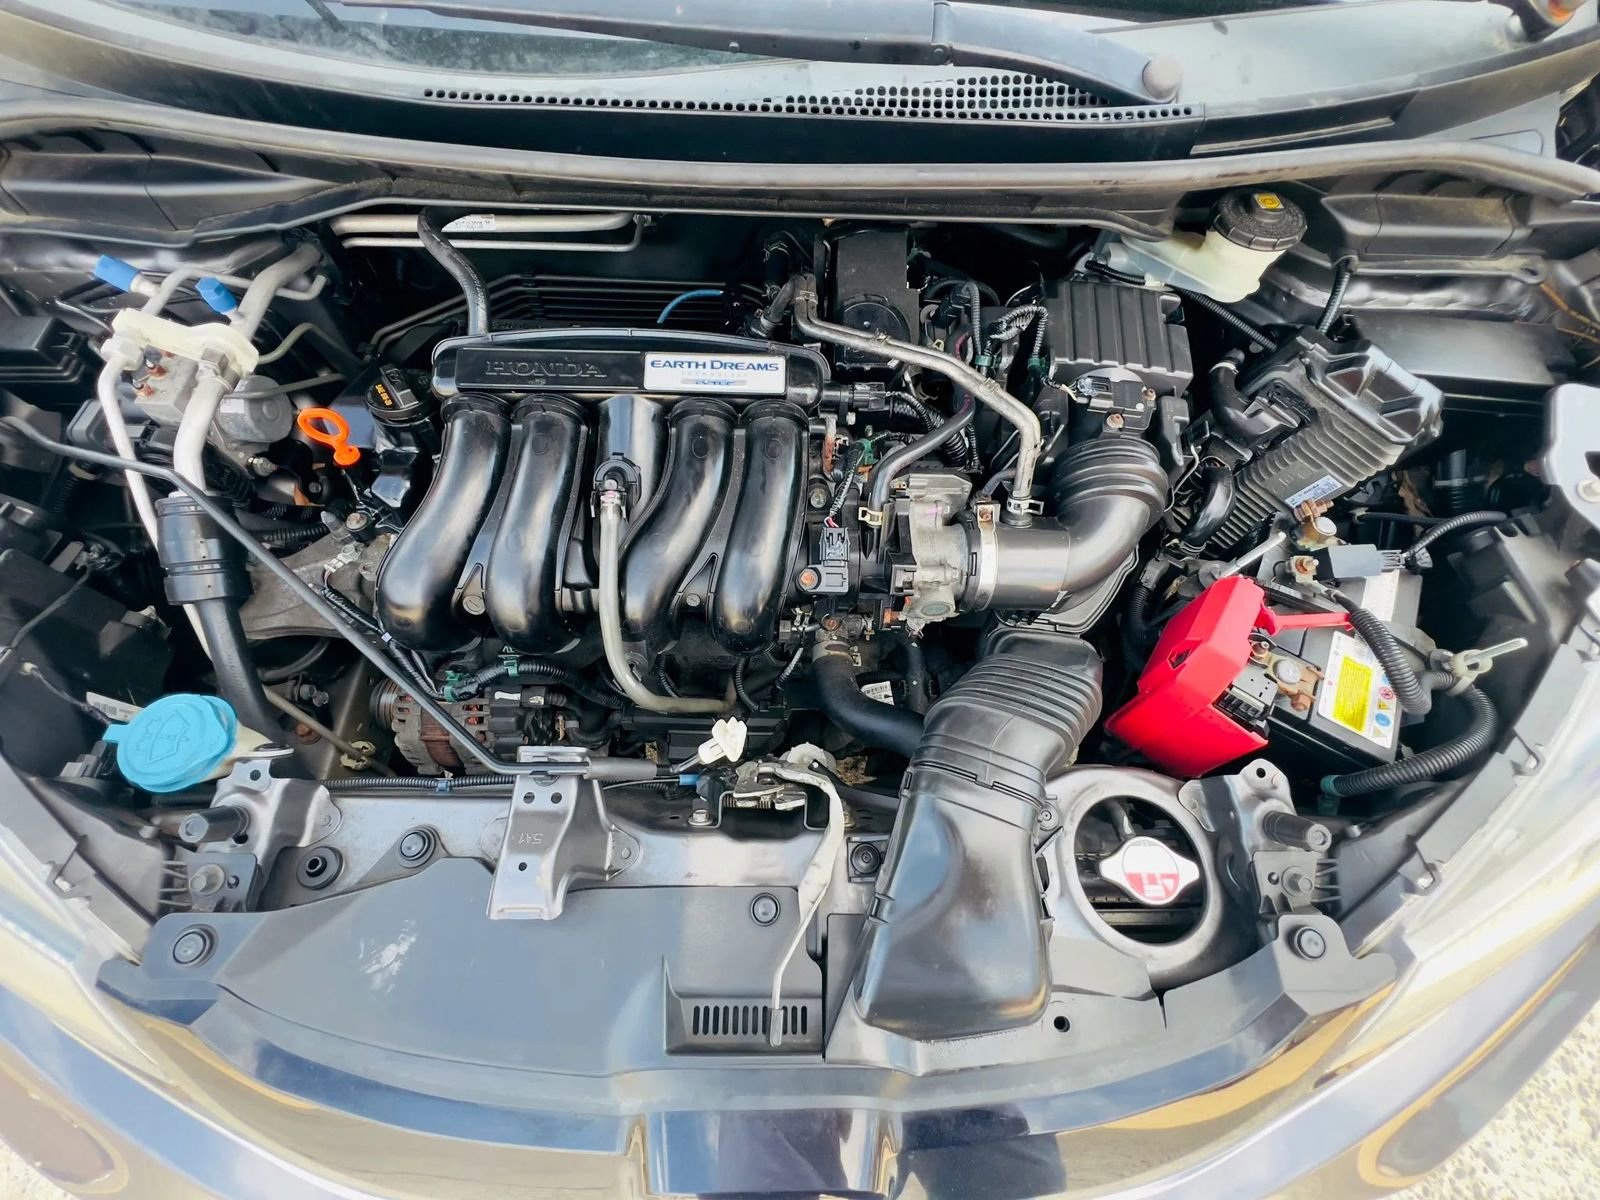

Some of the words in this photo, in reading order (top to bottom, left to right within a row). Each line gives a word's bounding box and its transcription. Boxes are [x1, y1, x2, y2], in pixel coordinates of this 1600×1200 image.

[485, 361, 608, 377] HONDA
[650, 360, 707, 369] EARTH
[710, 360, 779, 371] DREAMS
